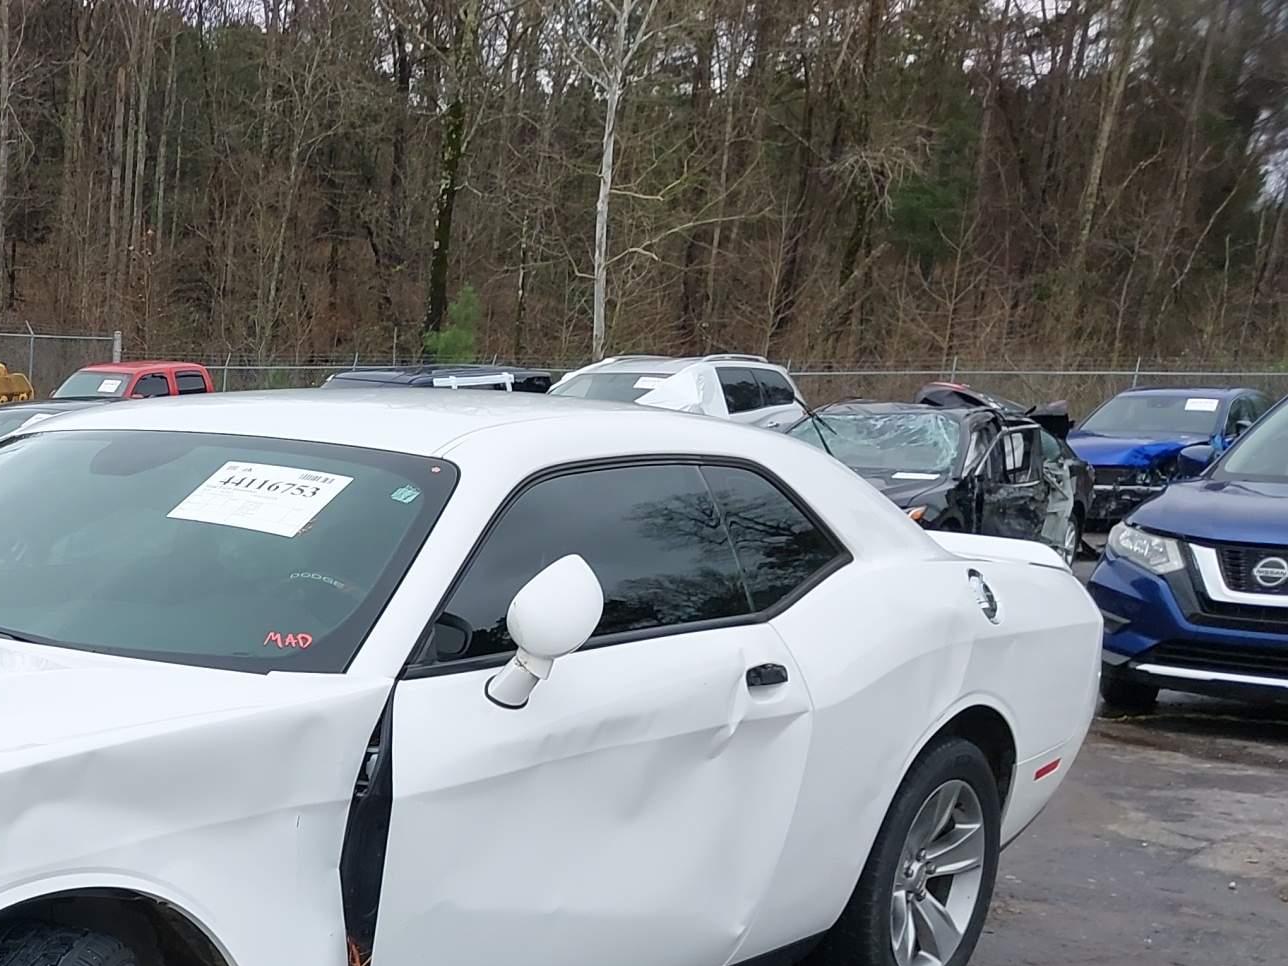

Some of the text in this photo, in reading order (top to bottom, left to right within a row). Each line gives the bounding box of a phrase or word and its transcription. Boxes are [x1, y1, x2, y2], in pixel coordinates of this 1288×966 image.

[219, 475, 321, 498] 44116753
[289, 572, 344, 589] DODGE
[263, 631, 313, 649] MAD
